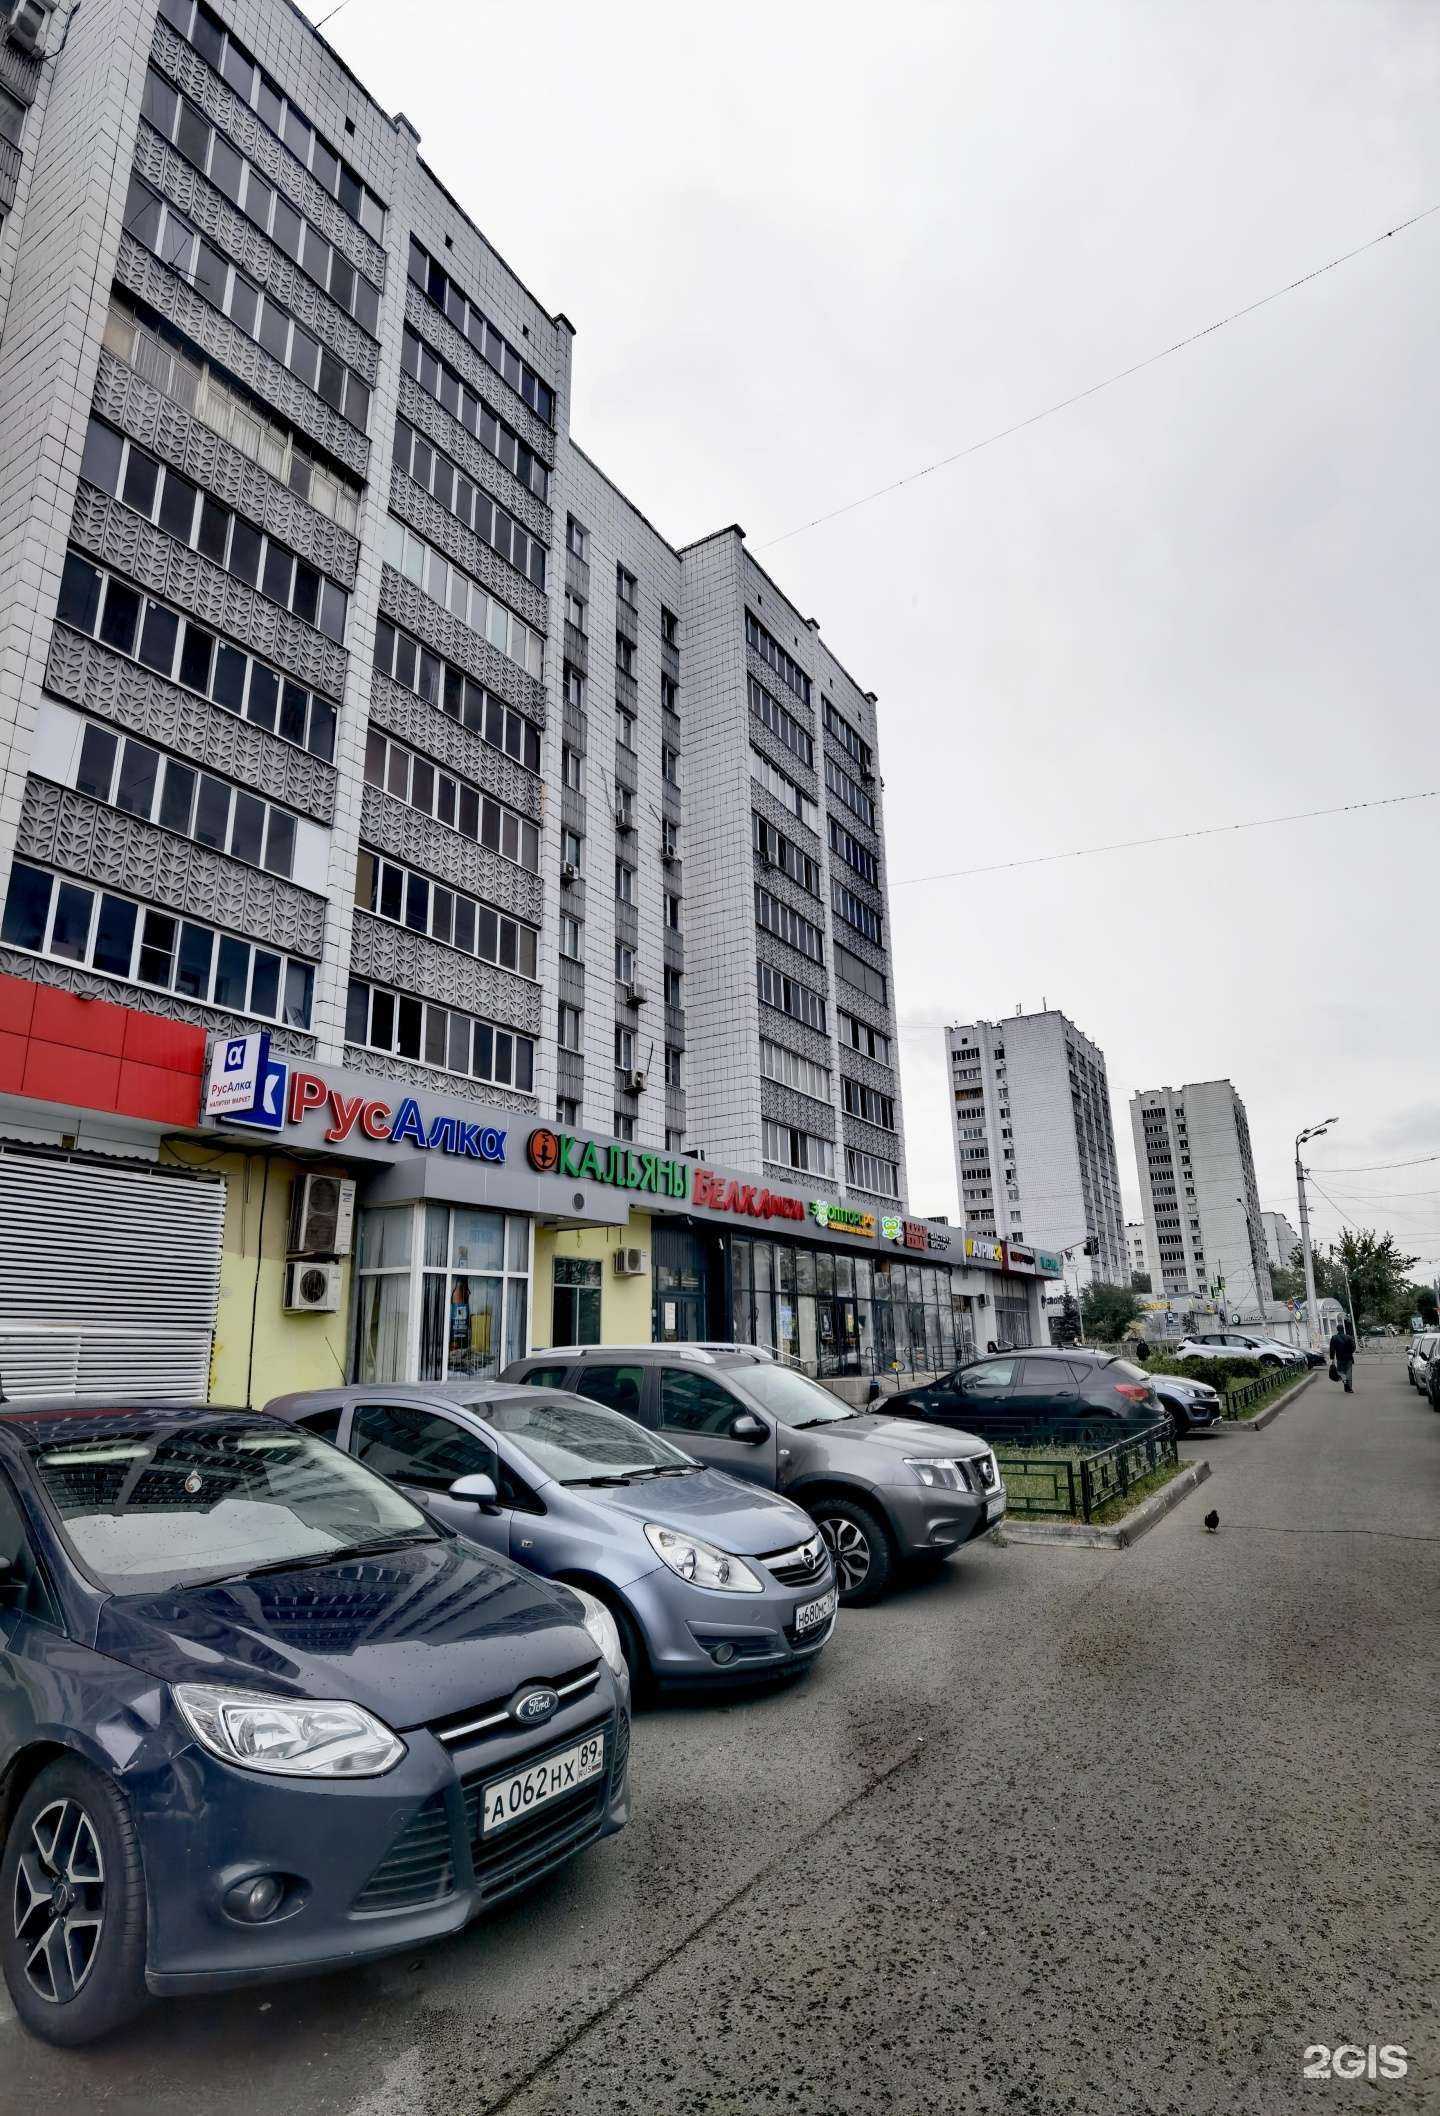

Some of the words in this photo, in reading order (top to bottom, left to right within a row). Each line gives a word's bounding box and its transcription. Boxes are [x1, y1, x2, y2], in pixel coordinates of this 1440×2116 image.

[558, 1133, 690, 1199] КАЛЬЯНЫ
[528, 1695, 550, 1716] Ford
[580, 1740, 598, 1768] 89
